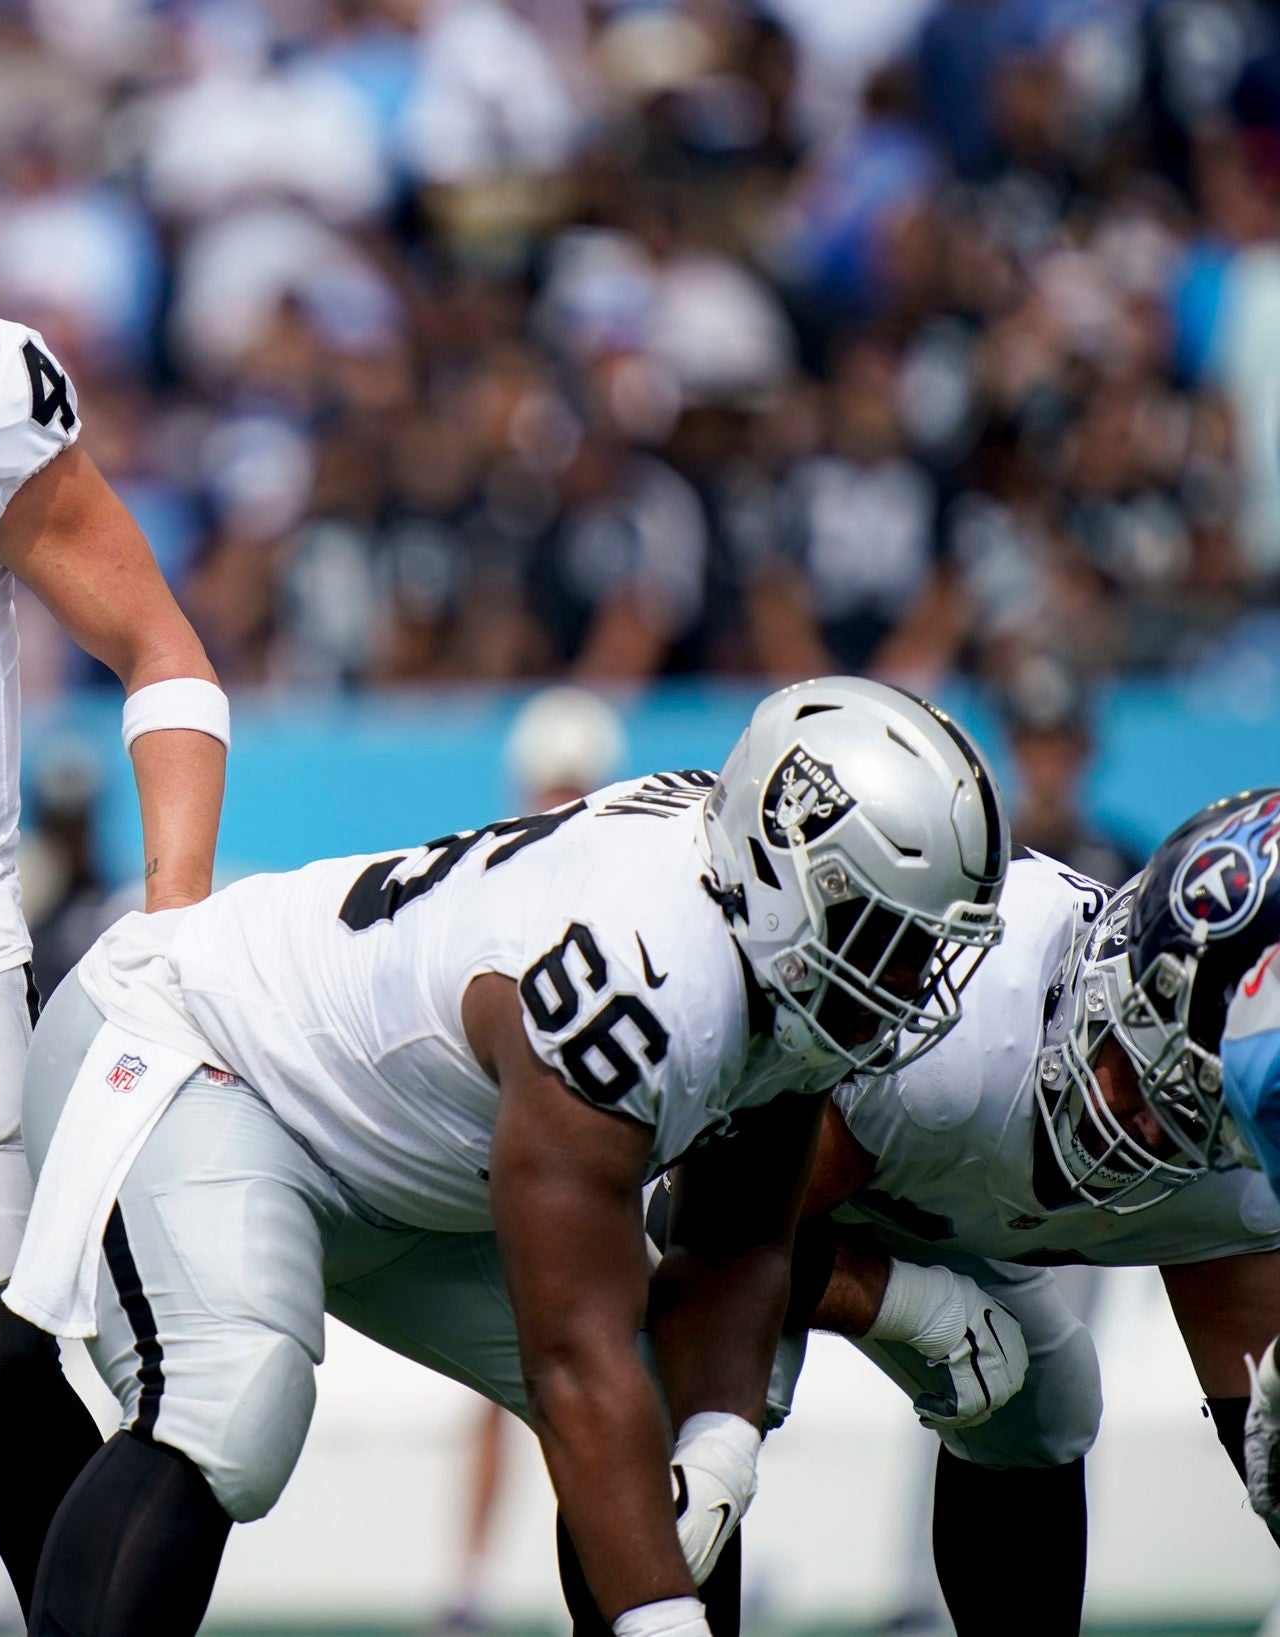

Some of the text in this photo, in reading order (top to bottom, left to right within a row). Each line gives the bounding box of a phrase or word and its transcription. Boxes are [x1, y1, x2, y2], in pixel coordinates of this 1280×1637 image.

[20, 336, 77, 438] 4
[793, 751, 850, 807] RAIDERS
[519, 917, 671, 1106] 66
[108, 1066, 136, 1091] NFL
[210, 1071, 234, 1083] NFL
